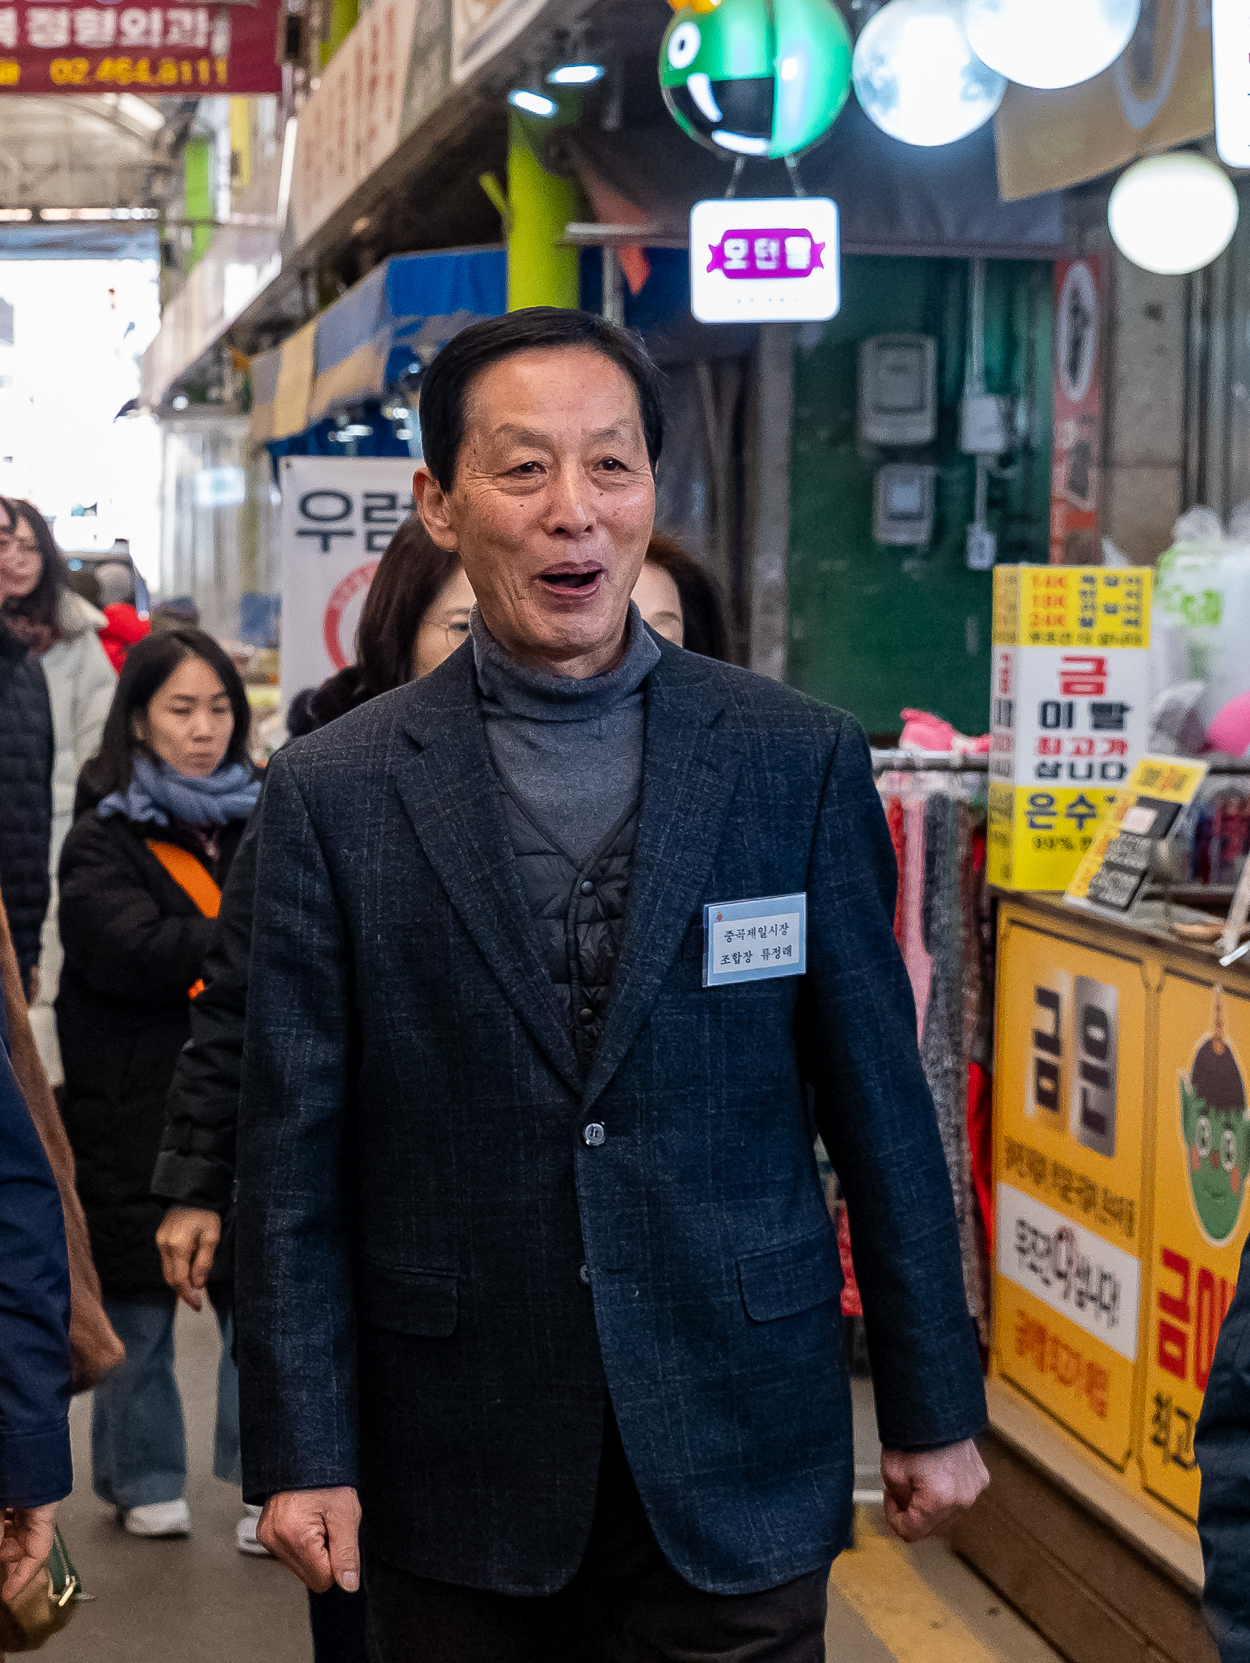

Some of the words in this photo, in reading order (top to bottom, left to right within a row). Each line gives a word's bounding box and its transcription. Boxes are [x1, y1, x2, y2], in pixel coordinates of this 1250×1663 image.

[1058, 655, 1108, 697] 금
[1036, 737, 1129, 757] 최고가
[1025, 792, 1117, 831] 은수
[723, 921, 790, 943] 중곡제일시장
[720, 949, 753, 966] 조합장
